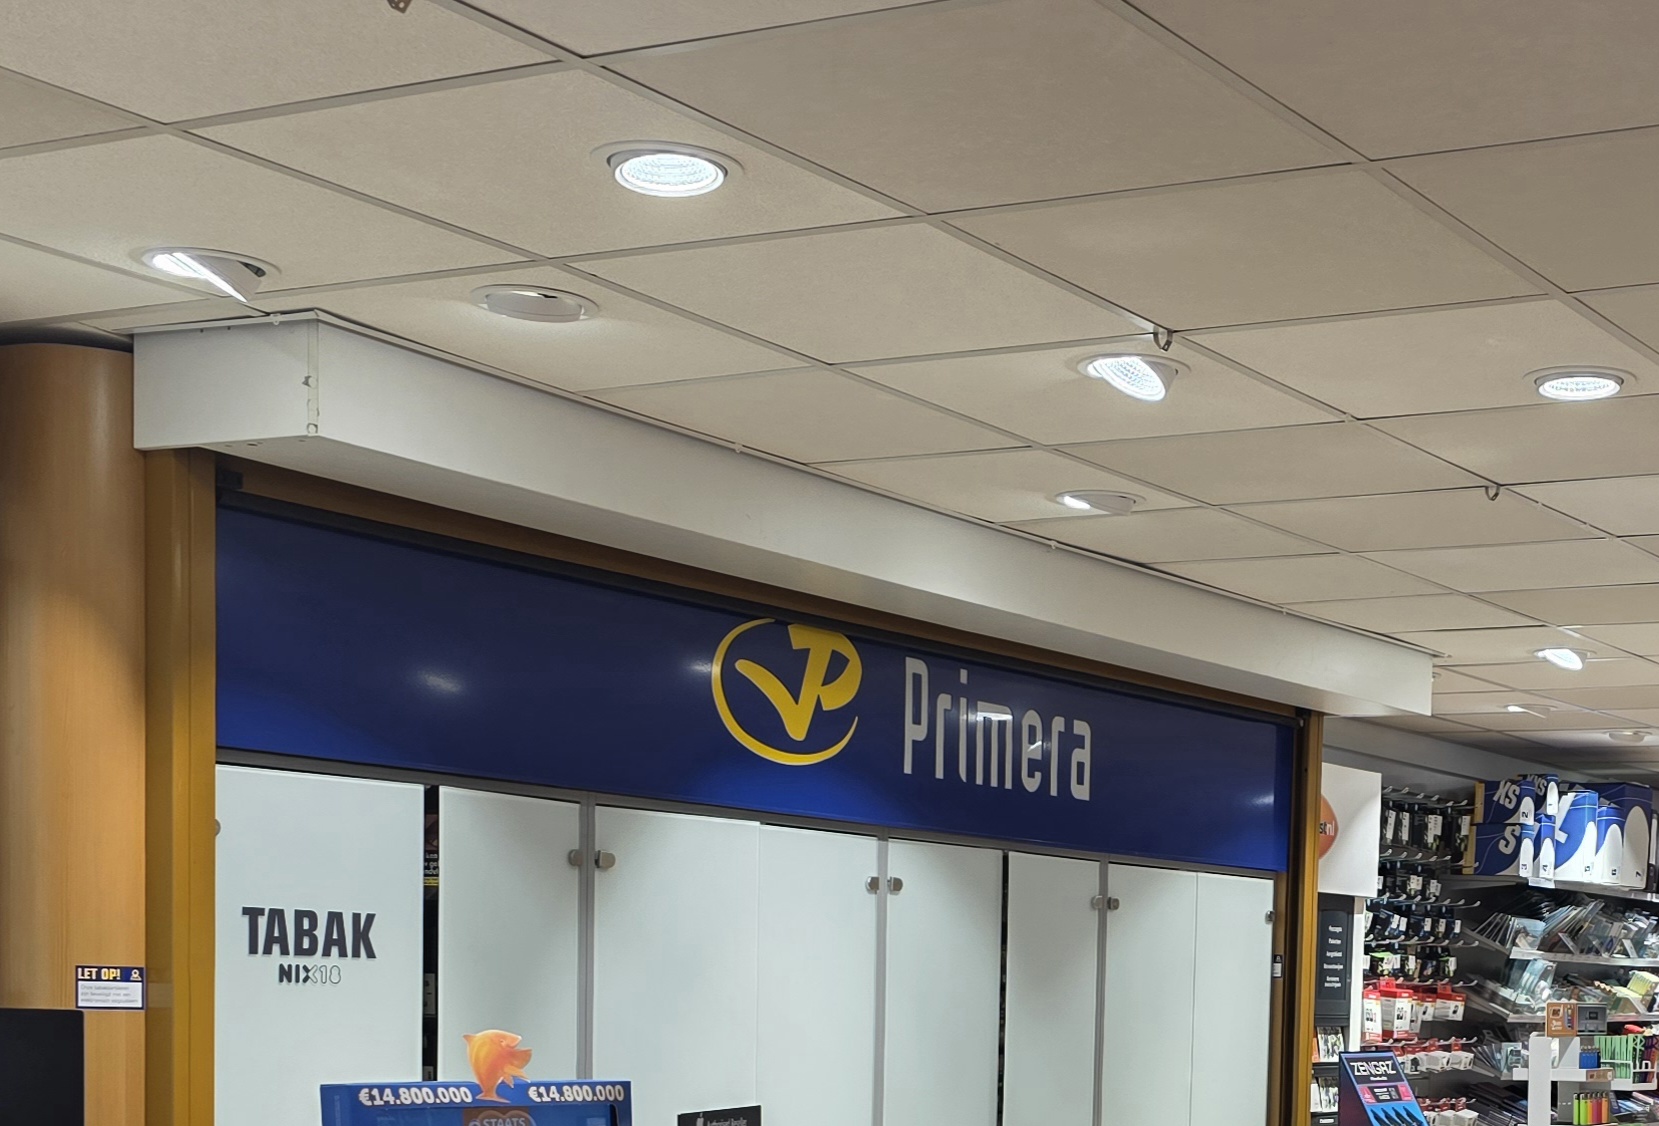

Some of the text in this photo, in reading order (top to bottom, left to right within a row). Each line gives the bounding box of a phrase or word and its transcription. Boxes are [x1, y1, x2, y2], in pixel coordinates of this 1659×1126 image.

[903, 655, 1092, 801] Primera
[1319, 821, 1335, 836] stnl
[242, 906, 377, 960] TABAK
[77, 967, 121, 980] LET OP!
[278, 963, 342, 986] NIX18
[1350, 1060, 1397, 1077] ZENGAZ
[358, 1086, 474, 1106] €14.800.000
[527, 1084, 625, 1103] €14.800.000
